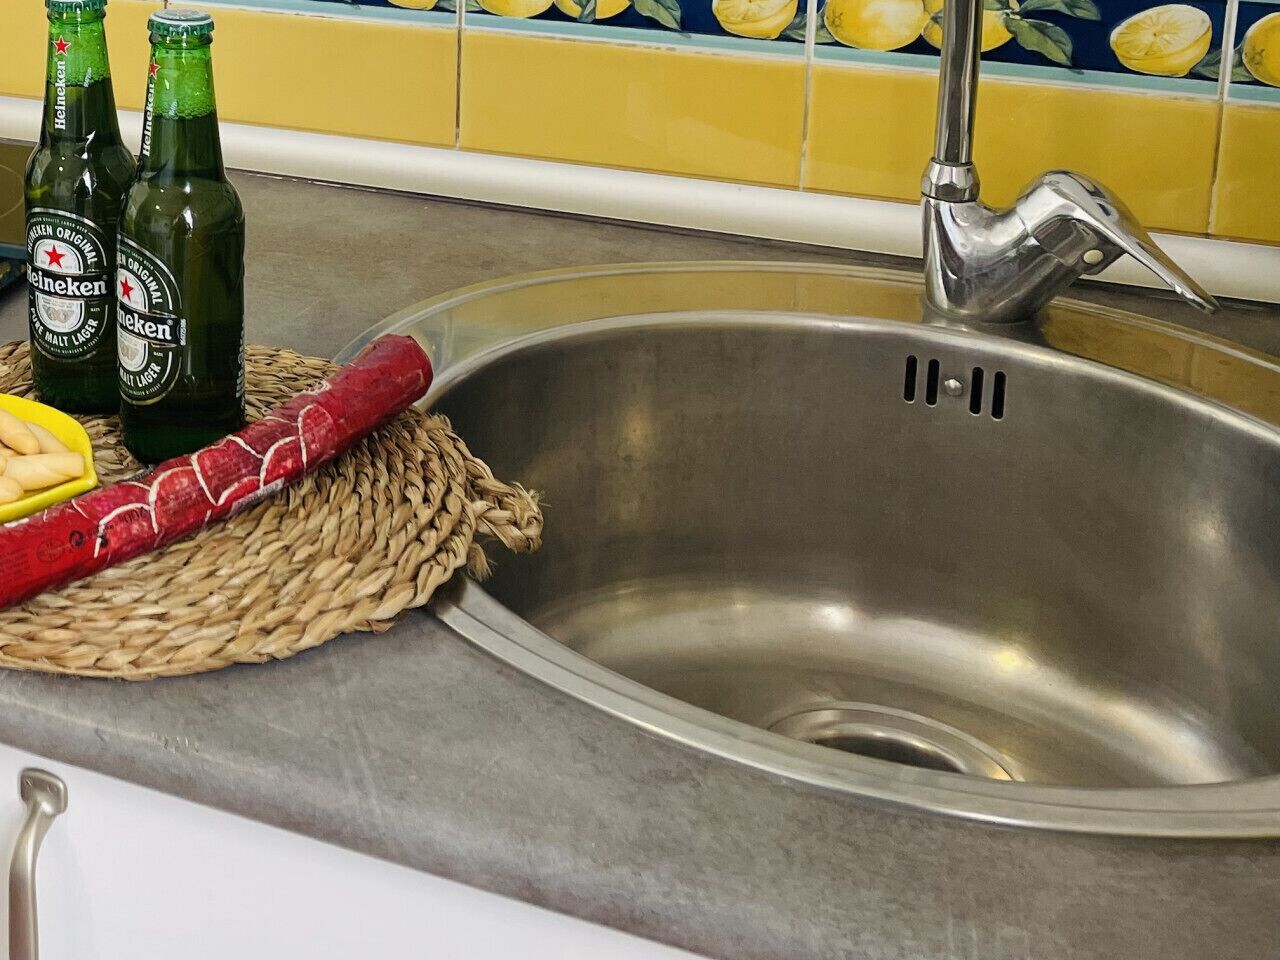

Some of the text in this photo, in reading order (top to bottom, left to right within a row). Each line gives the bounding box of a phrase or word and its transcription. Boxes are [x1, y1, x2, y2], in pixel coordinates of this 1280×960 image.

[54, 61, 66, 130] Heineken
[142, 83, 155, 157] Heineken
[27, 224, 53, 254] HEINEKEN
[56, 226, 98, 265] ORIGINAL
[27, 262, 108, 296] Heineken
[128, 257, 163, 305] ORIGINAL
[30, 307, 44, 335] PURE
[45, 331, 68, 347] MALT
[71, 318, 99, 345] LAGER
[118, 309, 173, 341] neken
[136, 362, 161, 387] LAGER
